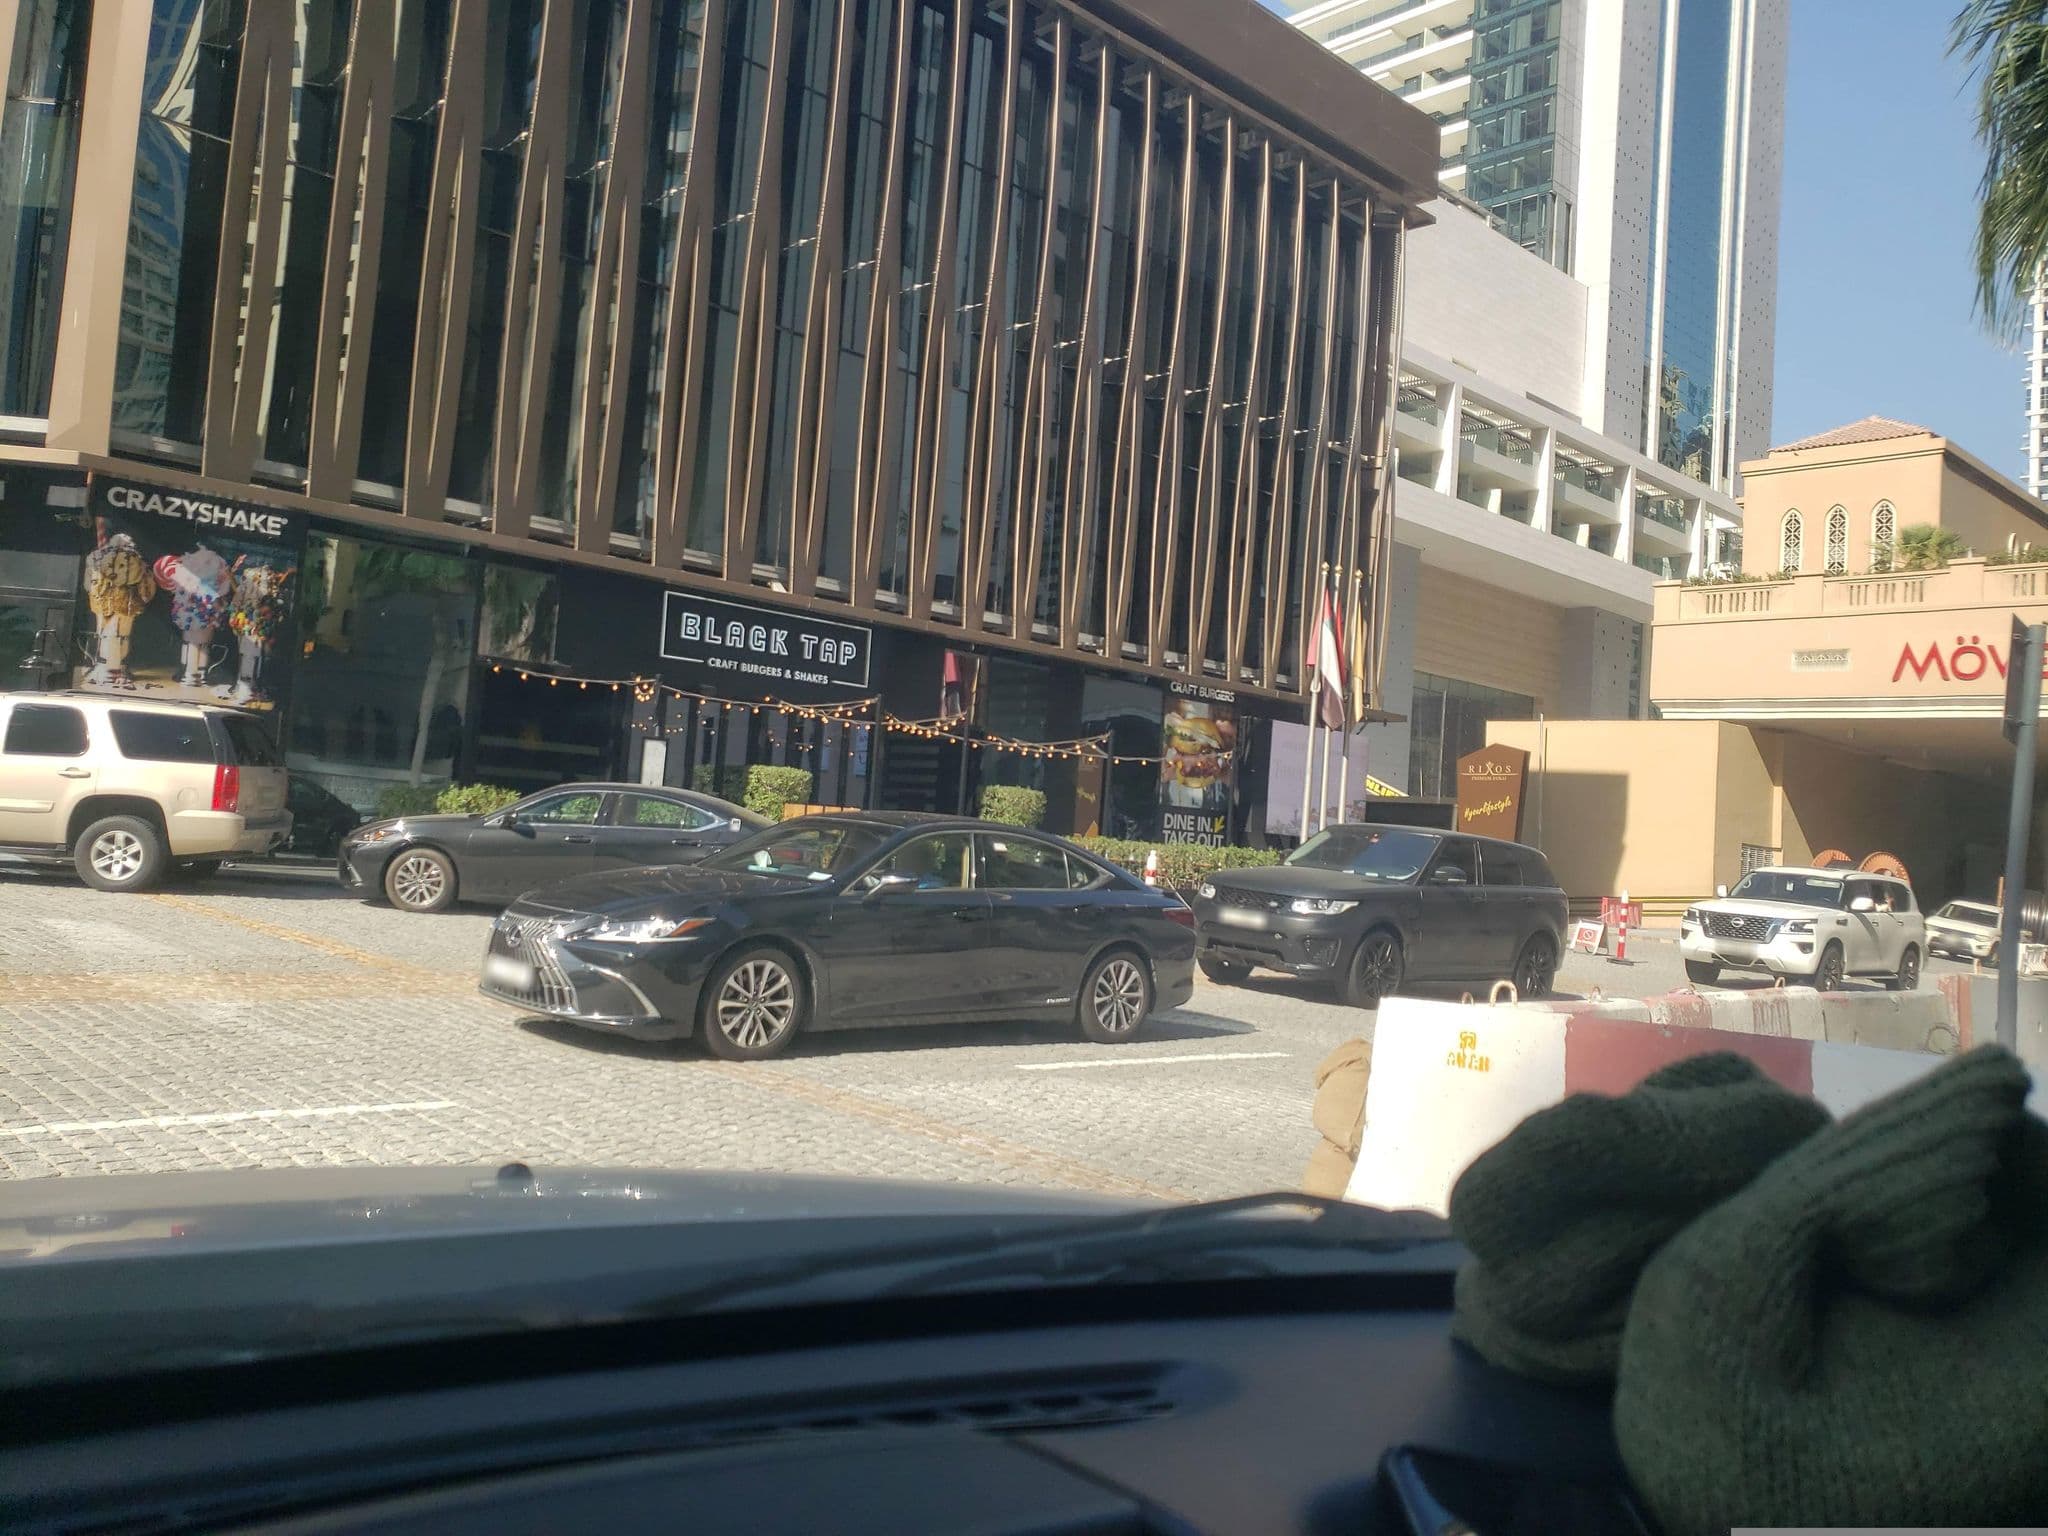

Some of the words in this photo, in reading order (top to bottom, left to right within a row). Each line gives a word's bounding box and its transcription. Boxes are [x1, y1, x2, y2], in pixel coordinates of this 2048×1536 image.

[680, 612, 789, 656] BLACK
[800, 634, 857, 666] TAP
[1892, 635, 2048, 682] MÖV
[707, 657, 739, 670] CRAFT
[740, 663, 783, 678] BURGERS
[784, 669, 792, 679] &
[794, 671, 829, 685] SHAKES
[1170, 681, 1198, 696] CRAFT
[1199, 686, 1235, 702] BURGERS
[1468, 761, 1512, 775] RIXOS
[1163, 812, 1195, 831] DINE
[1197, 816, 1214, 833] IN.
[1162, 829, 1195, 846] TAKE
[1196, 833, 1224, 849] OUT
